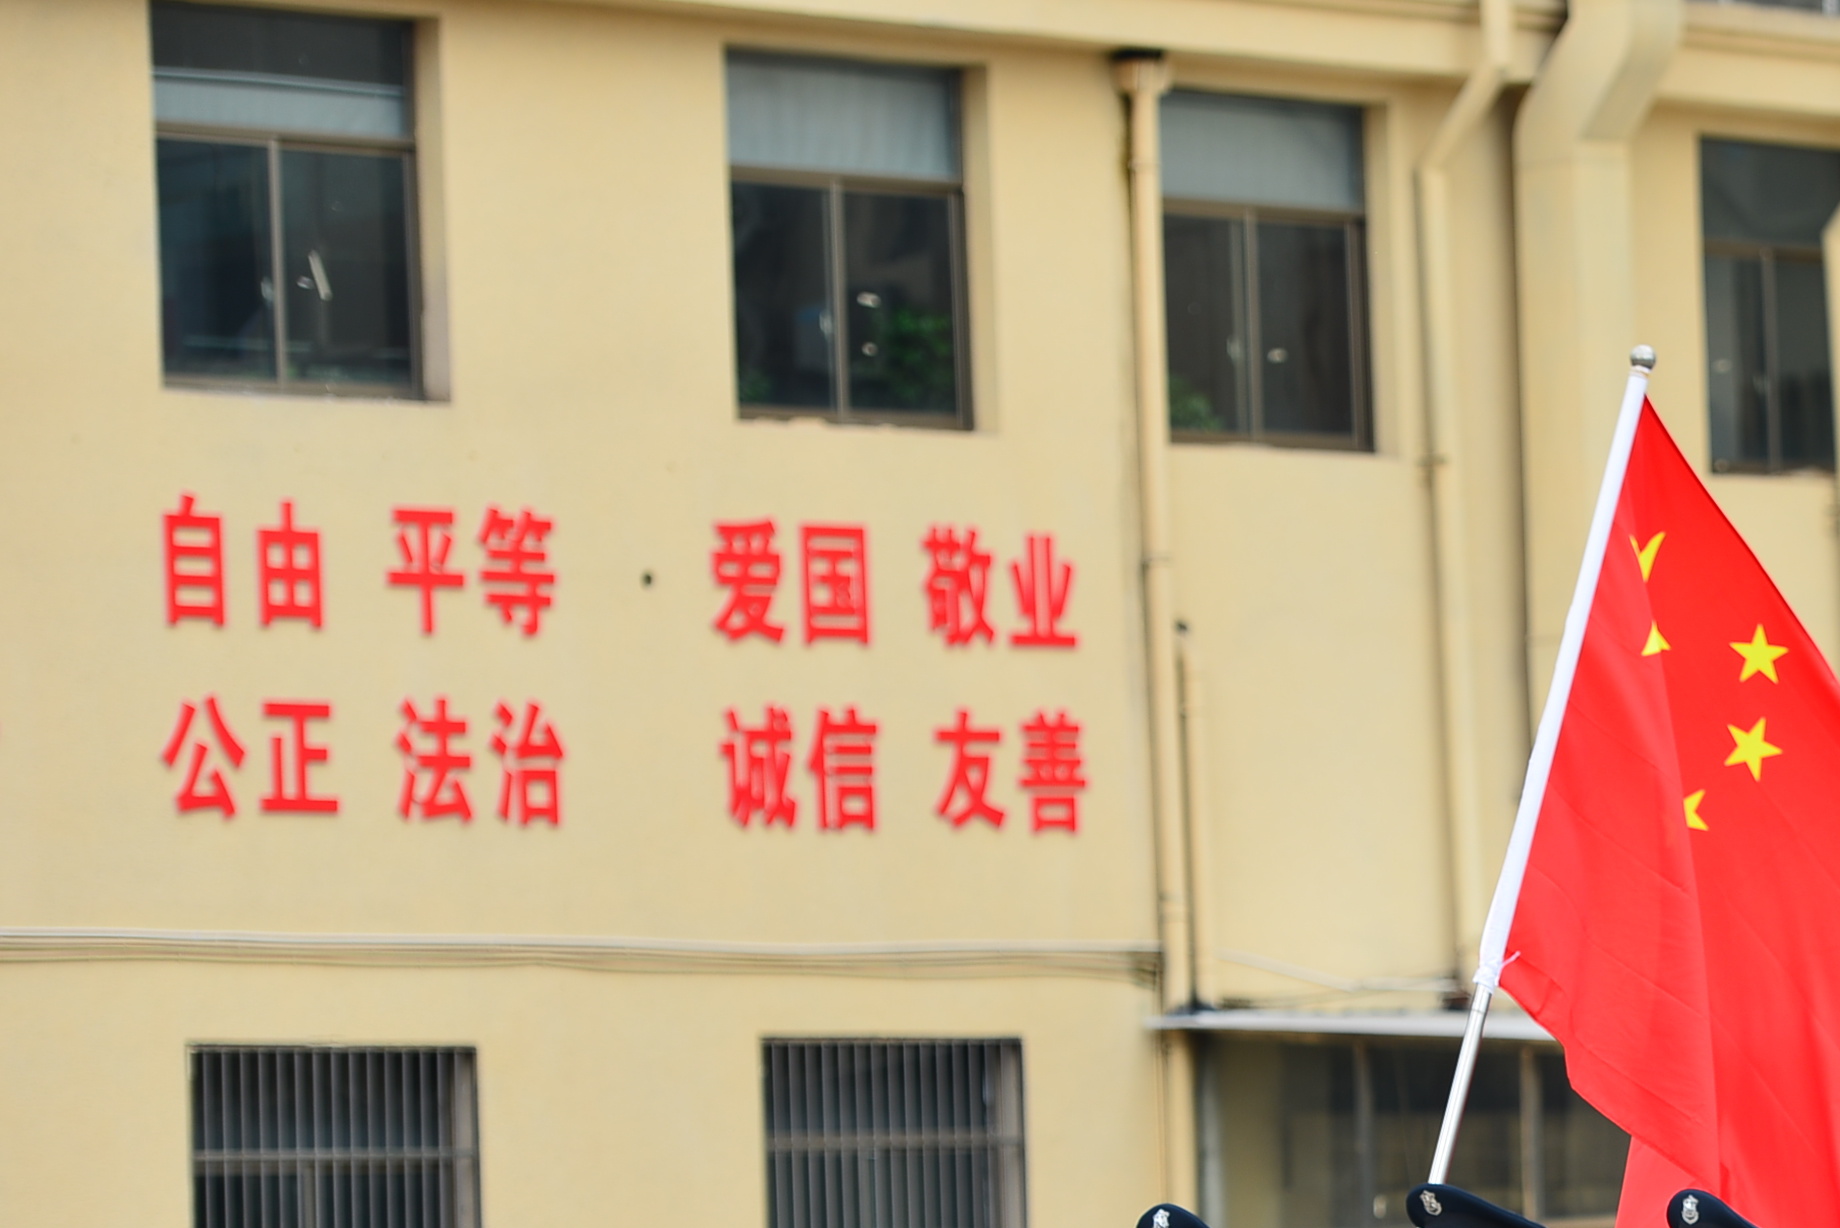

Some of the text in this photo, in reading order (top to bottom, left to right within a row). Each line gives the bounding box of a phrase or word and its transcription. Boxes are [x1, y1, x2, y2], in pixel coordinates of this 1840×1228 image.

[161, 493, 558, 638] 自由 平等
[710, 517, 1081, 650] 爱国 敬业
[161, 694, 566, 827] 公正 法治
[718, 704, 1089, 834] 诚信 友善
